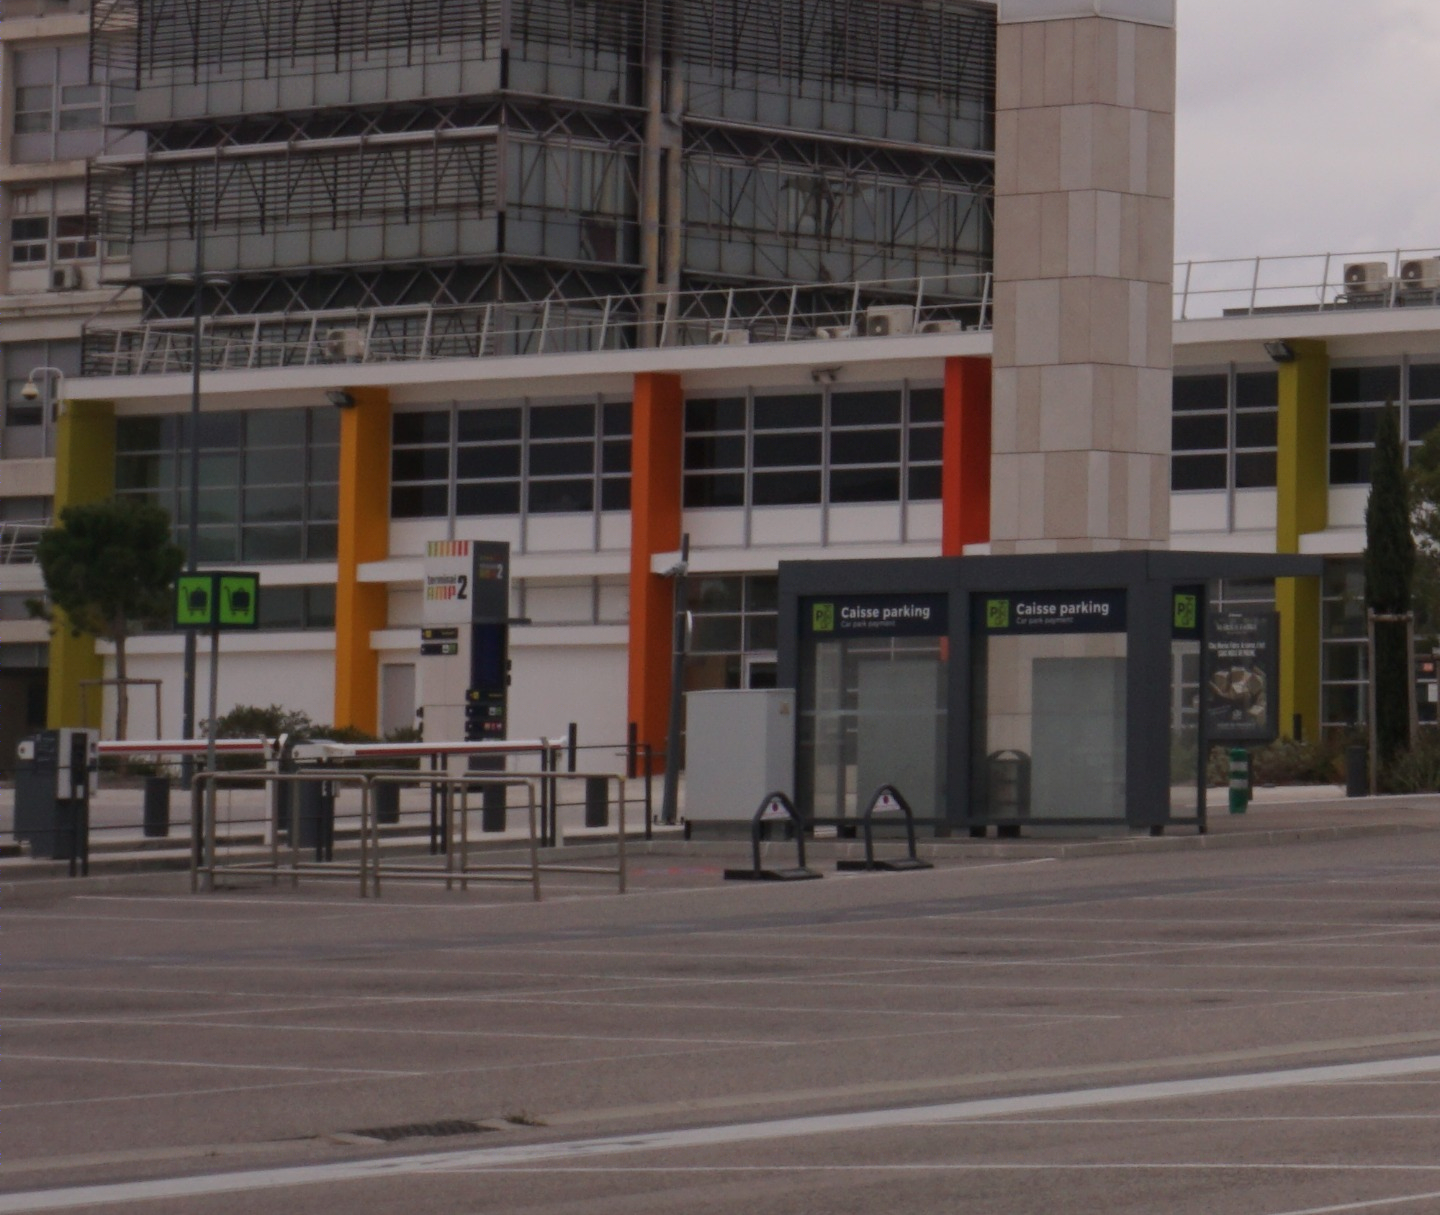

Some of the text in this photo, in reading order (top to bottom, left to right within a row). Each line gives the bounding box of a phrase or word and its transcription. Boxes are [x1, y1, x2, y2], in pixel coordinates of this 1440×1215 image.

[457, 575, 467, 599] 2
[841, 604, 930, 620] Caisse parking
[1016, 601, 1109, 616] Caisse parking
